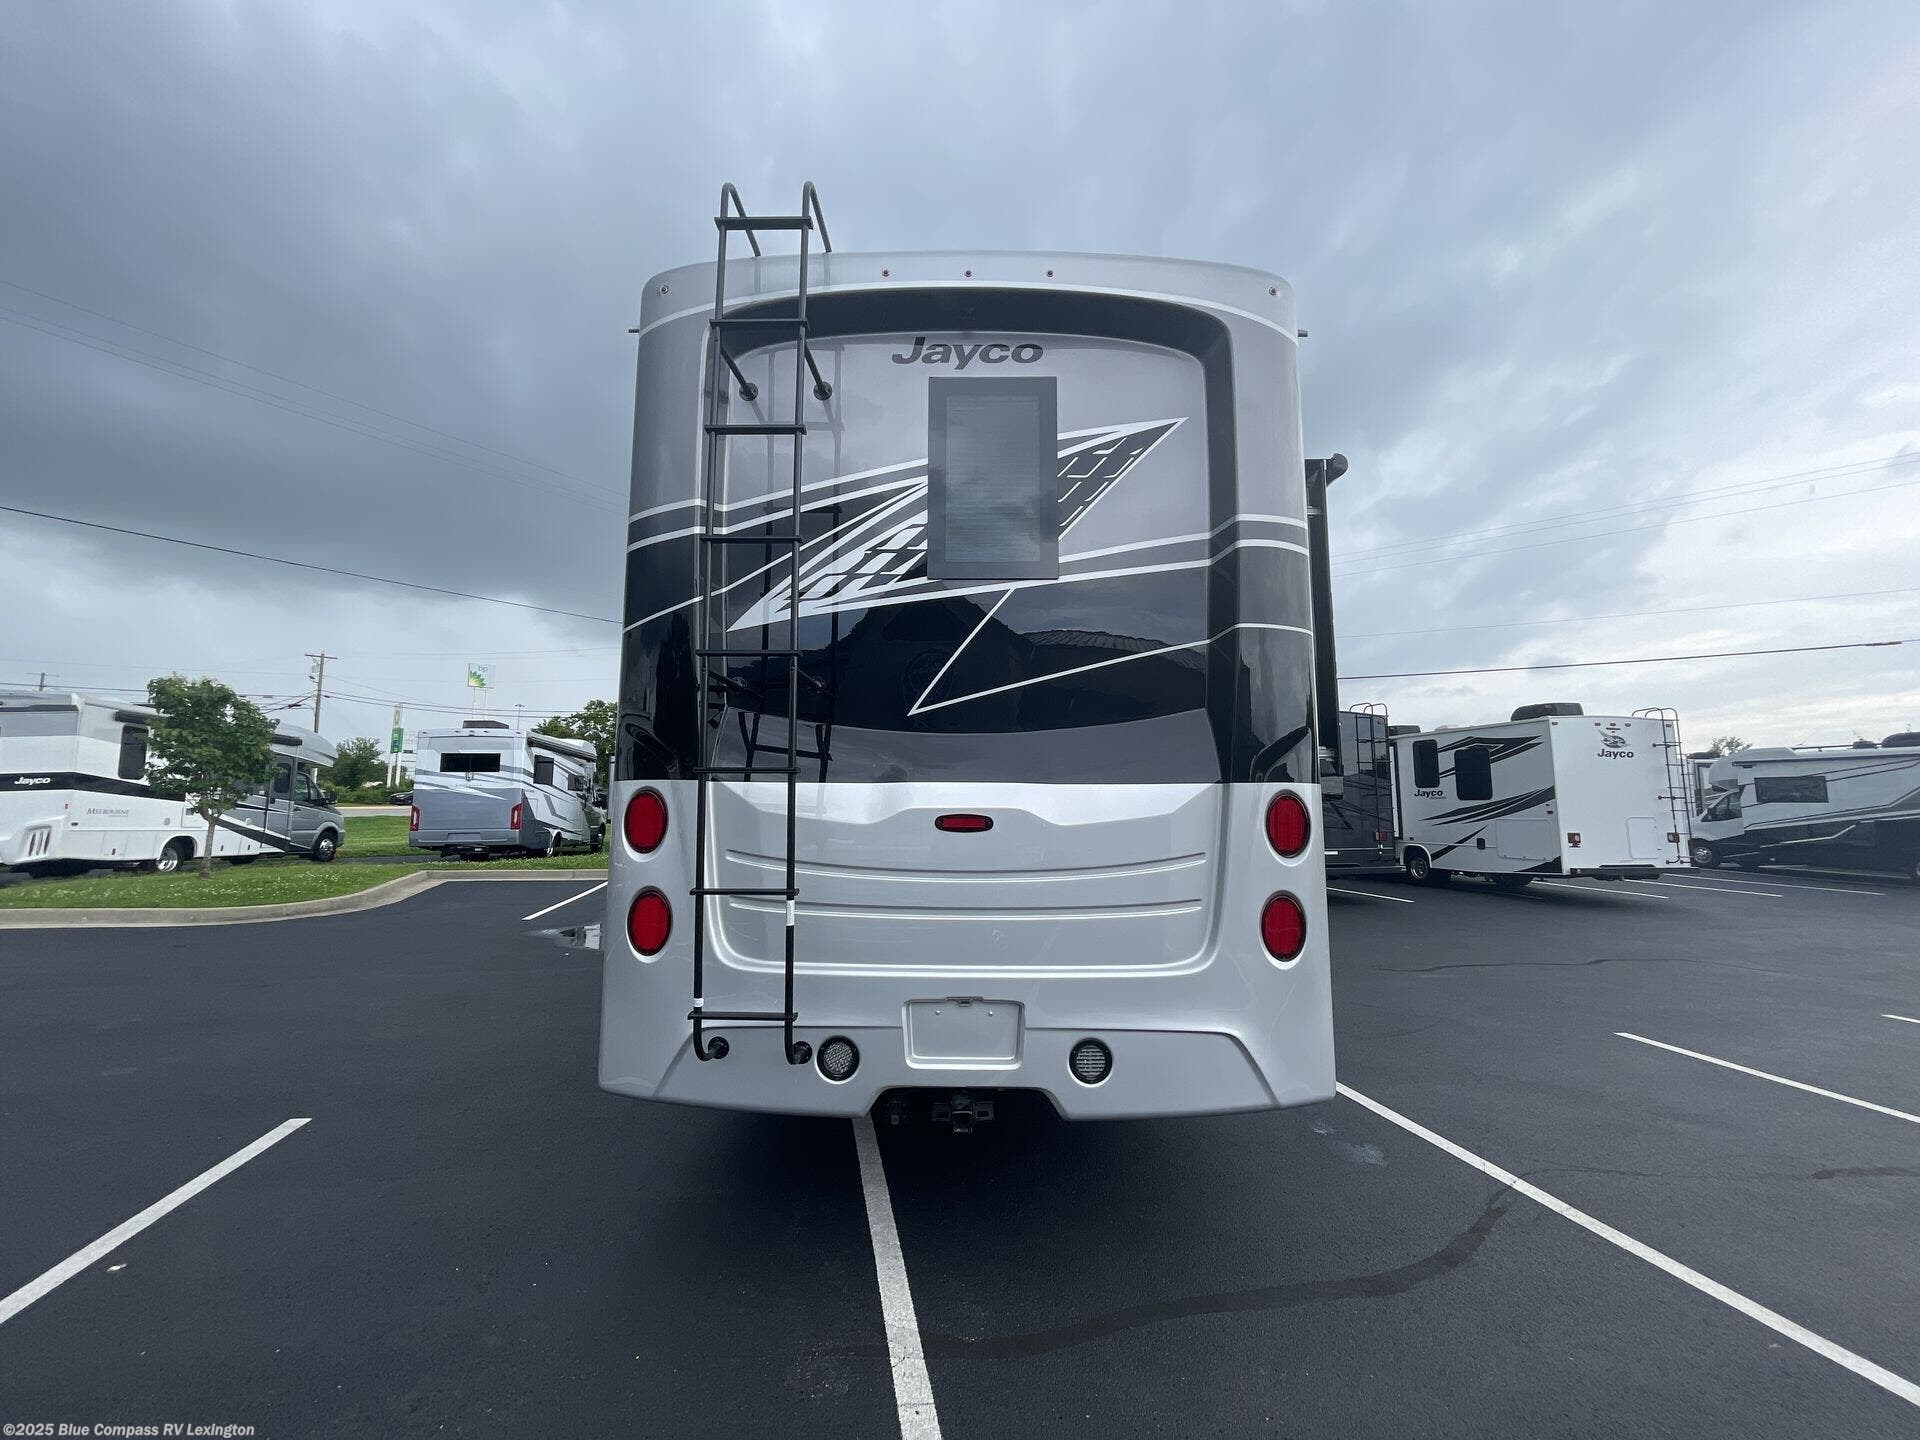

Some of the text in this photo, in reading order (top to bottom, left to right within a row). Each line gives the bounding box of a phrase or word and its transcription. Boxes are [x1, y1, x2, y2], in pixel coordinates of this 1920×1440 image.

[891, 336, 1044, 370] Jayco
[478, 665, 488, 673] bp
[1597, 748, 1634, 760] Jayco
[14, 776, 51, 785] Jayco
[1414, 789, 1443, 798] Jayco
